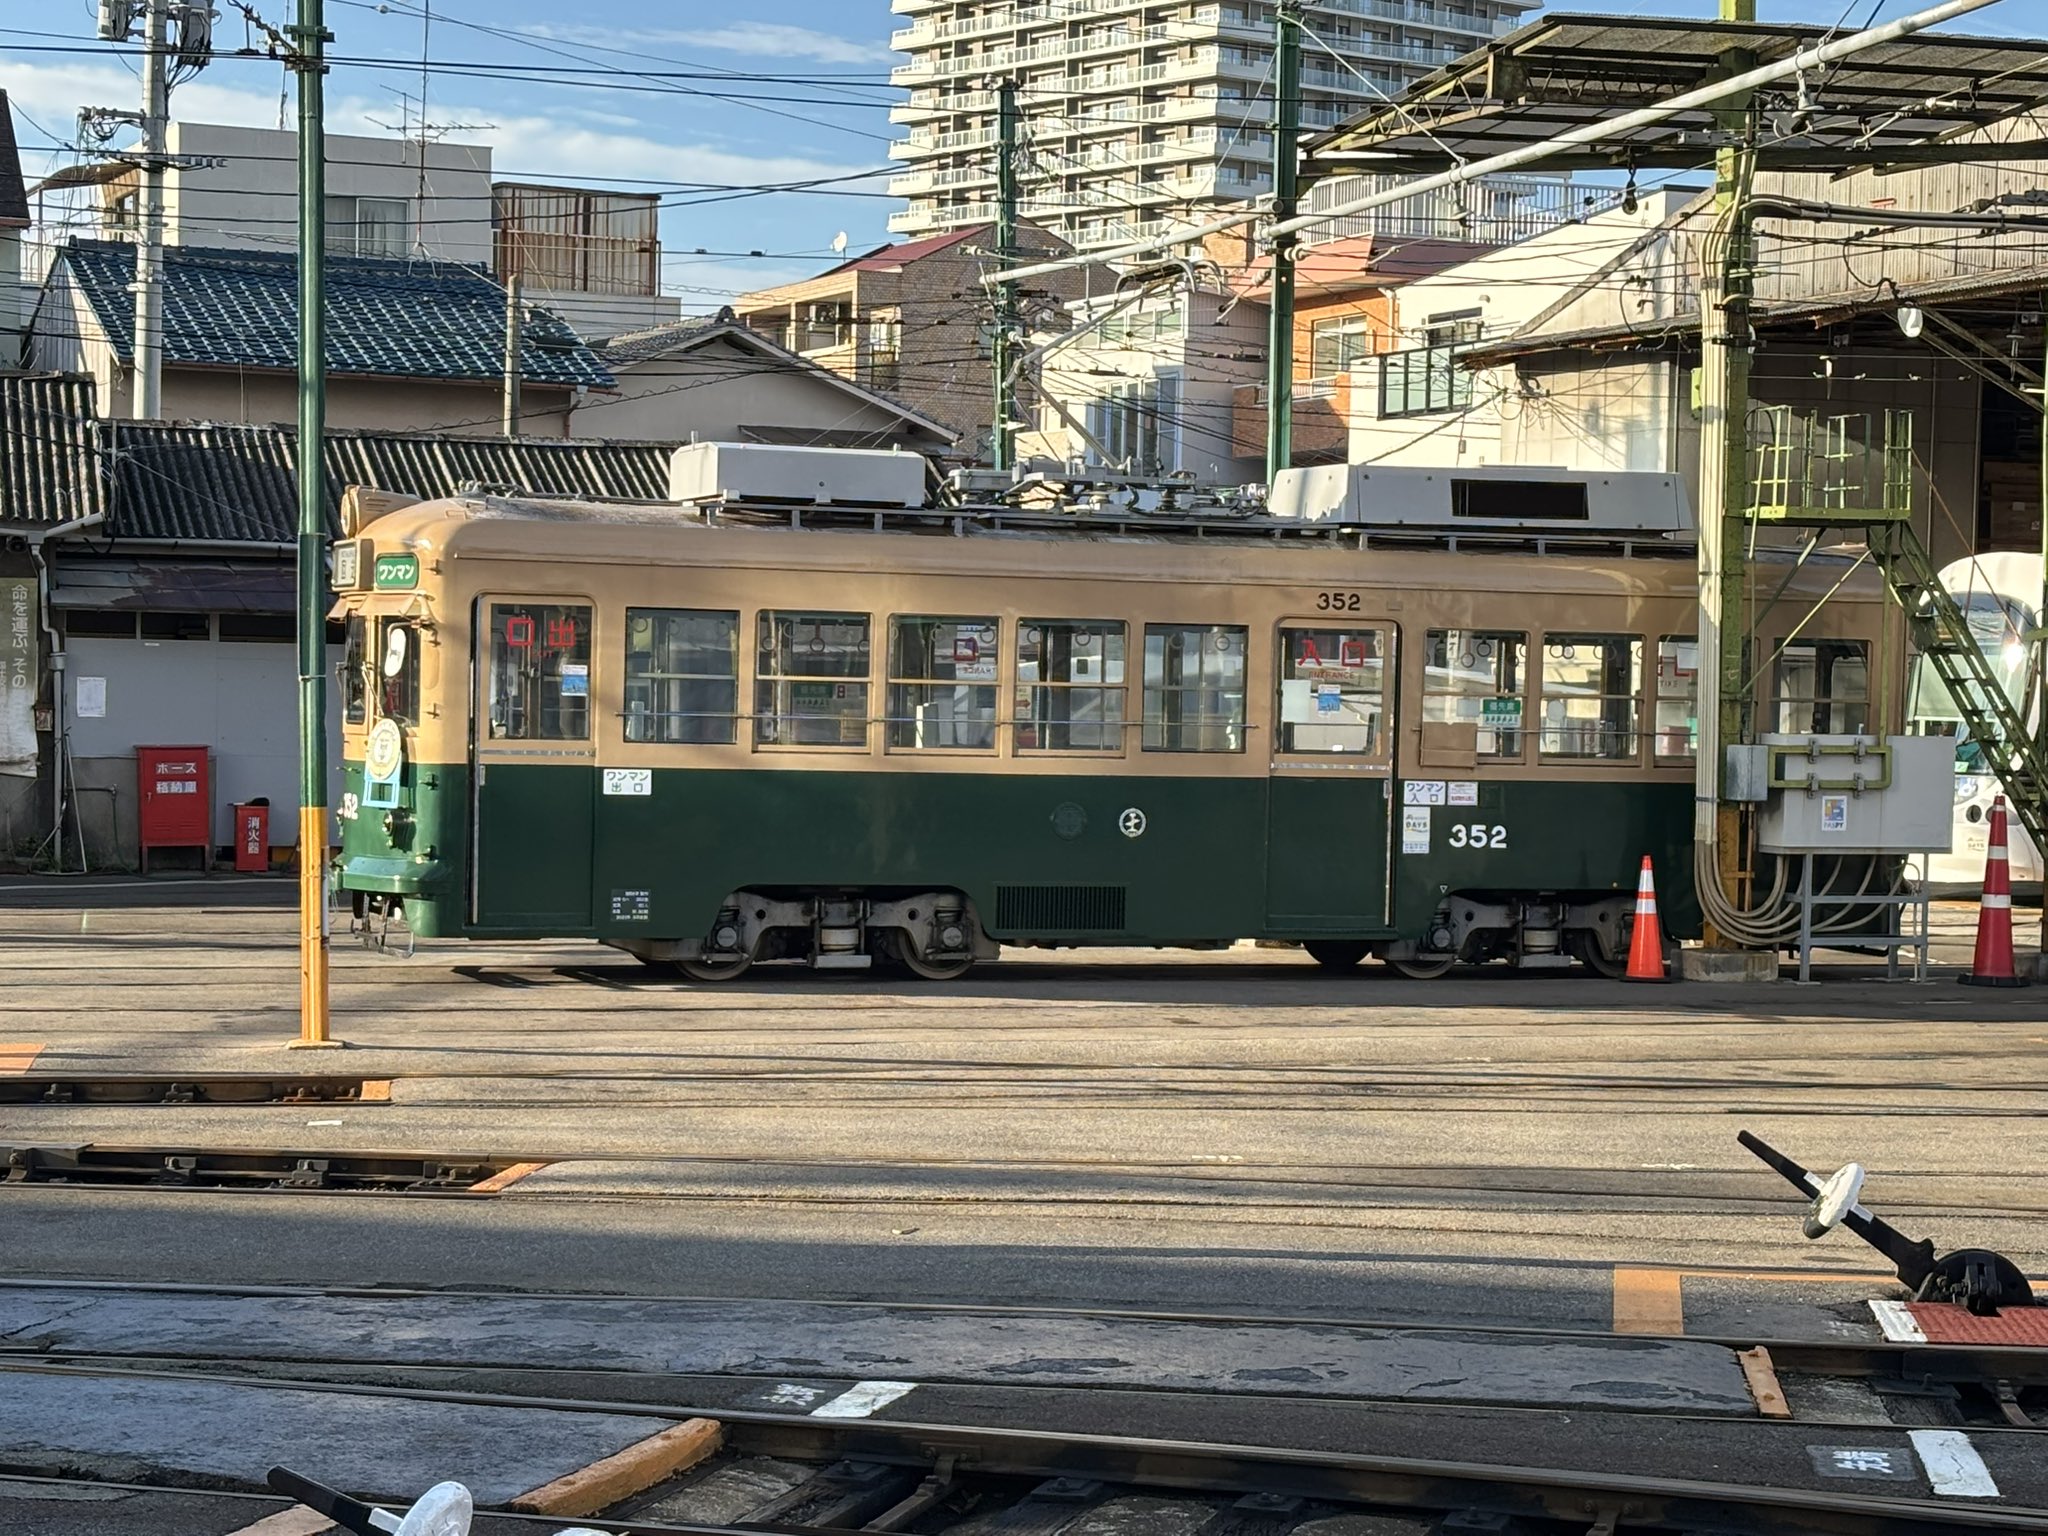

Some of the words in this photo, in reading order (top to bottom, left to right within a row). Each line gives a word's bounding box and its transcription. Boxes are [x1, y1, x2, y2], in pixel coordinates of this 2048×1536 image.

[379, 565, 415, 580] ワンマン
[1316, 593, 1361, 611] 352
[158, 762, 197, 773] ホース
[606, 771, 649, 781] ワンマン
[157, 782, 197, 793] 格納庫
[1406, 783, 1444, 792] ワンマン
[248, 817, 260, 854] 消火器
[1448, 824, 1507, 848] 352
